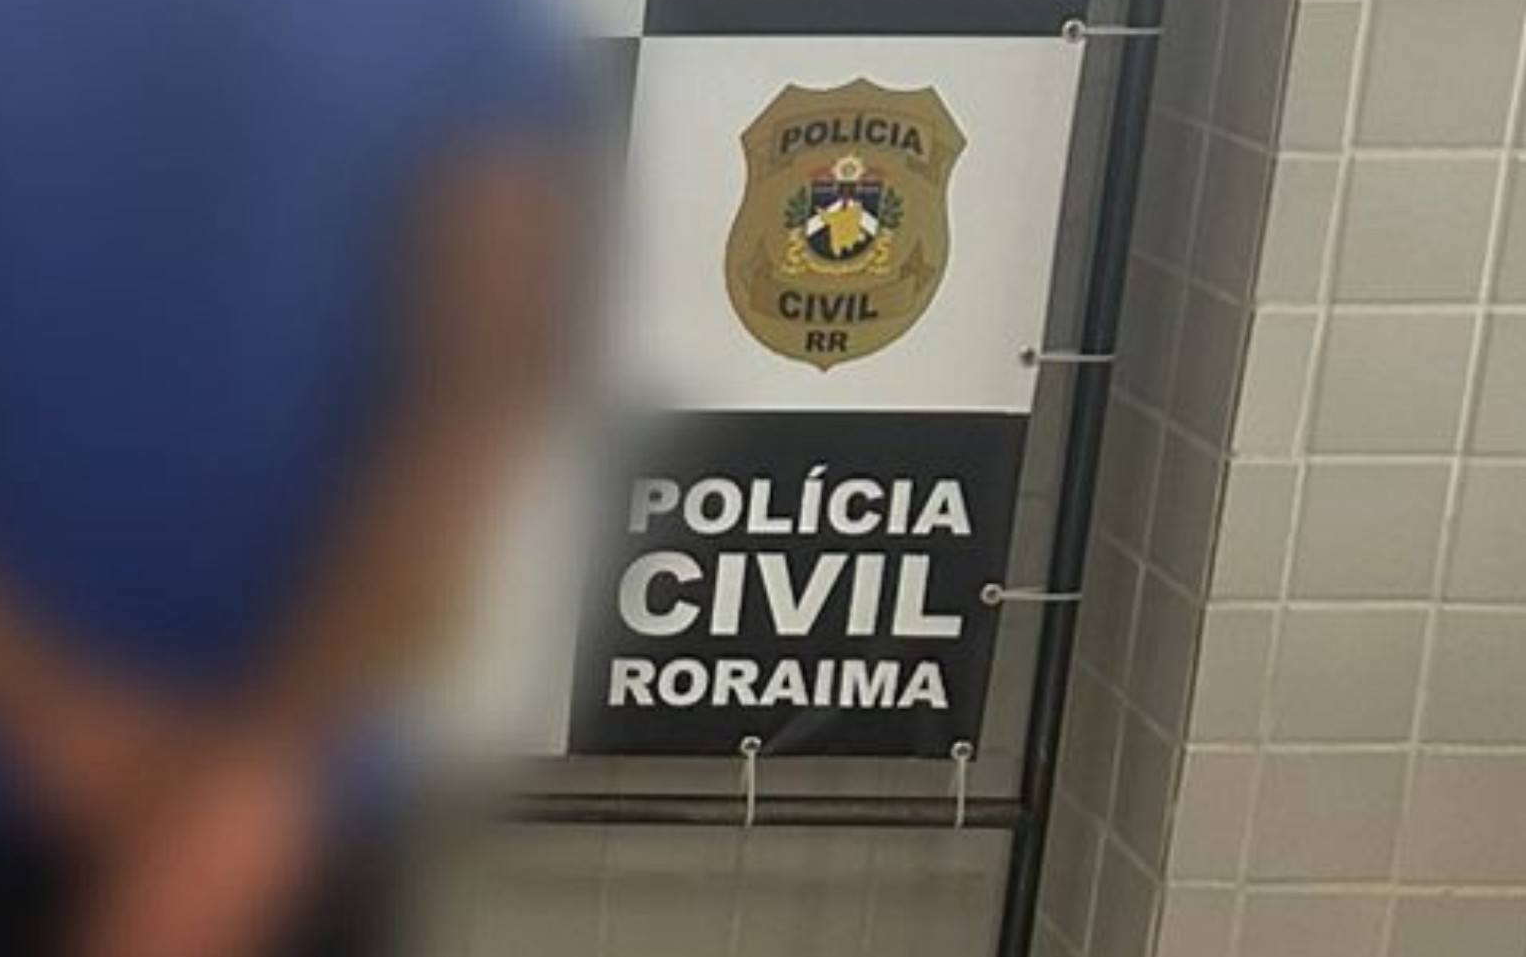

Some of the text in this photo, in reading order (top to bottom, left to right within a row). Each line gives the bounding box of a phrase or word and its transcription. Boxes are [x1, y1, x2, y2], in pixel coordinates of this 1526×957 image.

[779, 113, 924, 155] POLÍCIA
[778, 290, 879, 323] CIVIL
[804, 329, 848, 352] RR
[627, 464, 971, 535] POLÍCIA
[616, 551, 962, 637] CIVIL
[607, 657, 949, 710] RORAIMA
